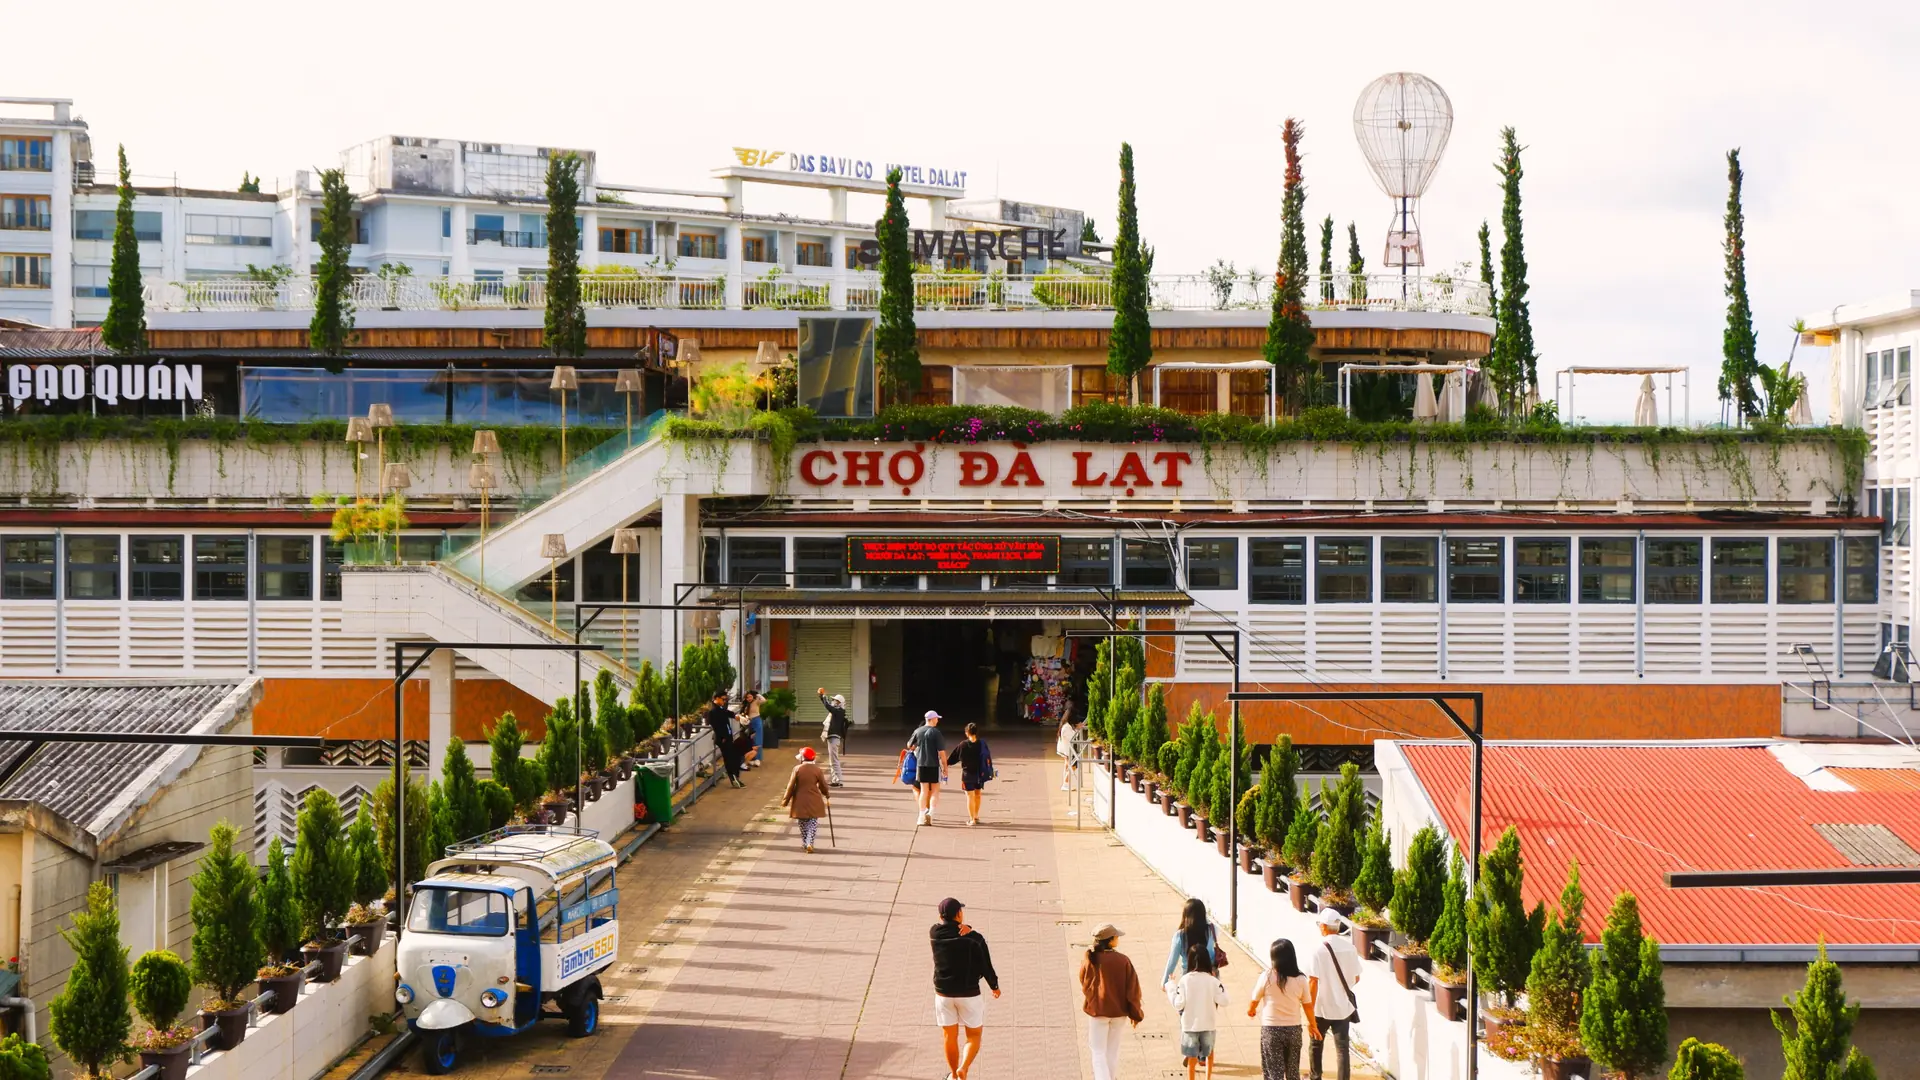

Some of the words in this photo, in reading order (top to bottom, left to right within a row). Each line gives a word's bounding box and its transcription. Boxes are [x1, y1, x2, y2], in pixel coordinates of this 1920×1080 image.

[790, 152, 815, 173] DAS
[819, 155, 873, 180] BAVICO
[929, 168, 967, 188] DALAT
[913, 228, 1068, 261] MARCHÉ
[8, 363, 86, 406] GẠO
[94, 357, 203, 406] QUÁN
[800, 442, 925, 496] CHỢ
[958, 441, 1044, 487] ĐÀ
[1071, 451, 1192, 497] LẠT
